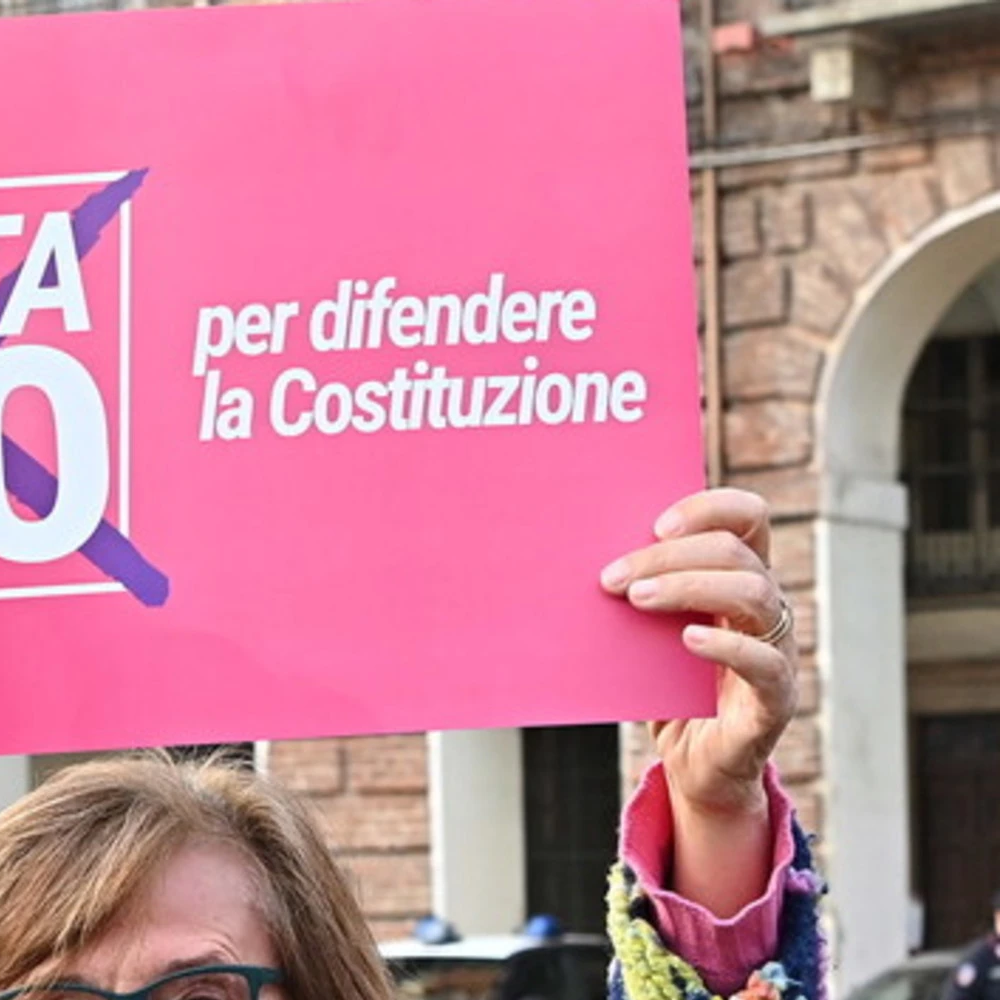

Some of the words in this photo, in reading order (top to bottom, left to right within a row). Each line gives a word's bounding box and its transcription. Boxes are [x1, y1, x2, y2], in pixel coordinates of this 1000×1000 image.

[192, 301, 299, 377] per
[309, 273, 596, 352] difendere
[199, 369, 254, 441] la
[270, 356, 647, 437] Costituzione
